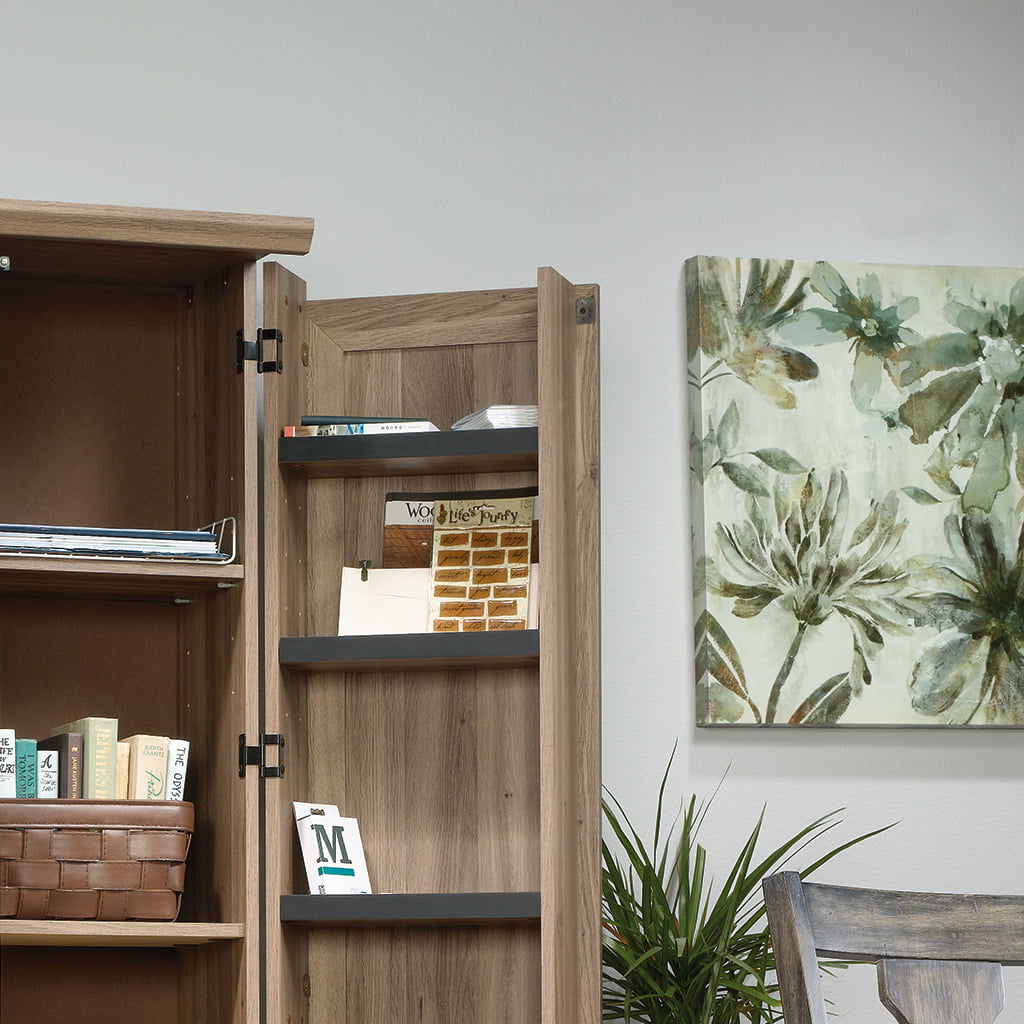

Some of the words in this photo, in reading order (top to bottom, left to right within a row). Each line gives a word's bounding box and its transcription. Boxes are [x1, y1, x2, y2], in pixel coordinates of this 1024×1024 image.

[174, 747, 186, 767] THE
[27, 763, 35, 787] WAS
[310, 824, 352, 864] M
